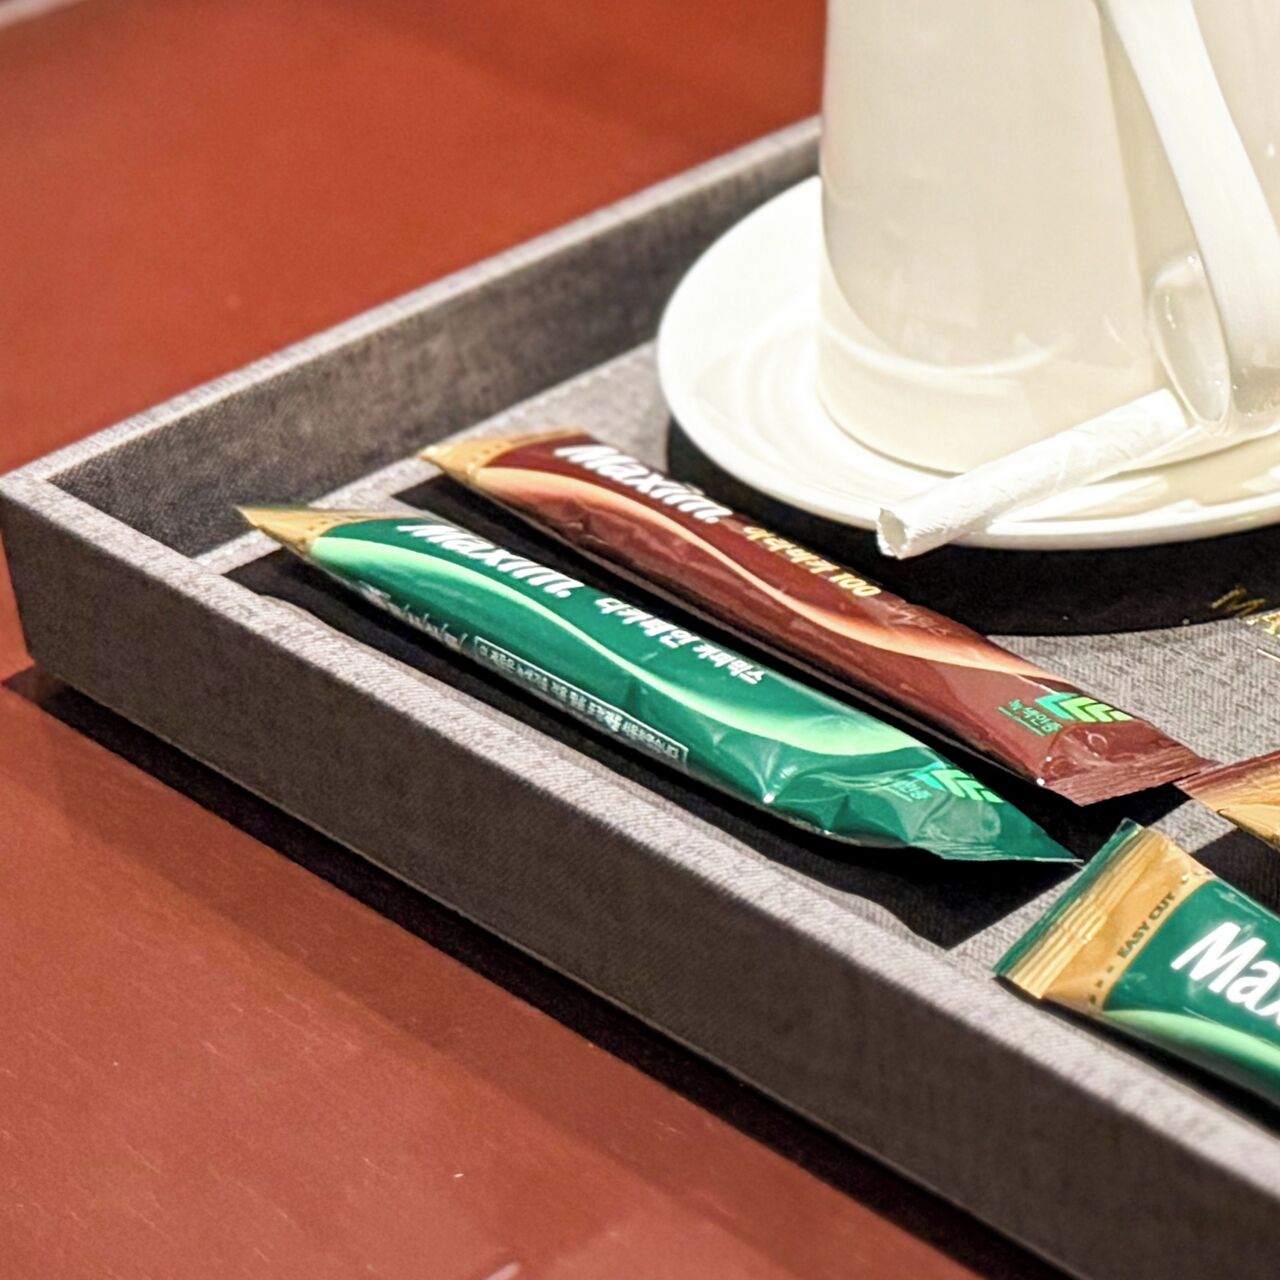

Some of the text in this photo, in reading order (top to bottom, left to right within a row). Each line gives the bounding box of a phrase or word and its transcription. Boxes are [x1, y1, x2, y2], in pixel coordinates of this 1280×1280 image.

[827, 571, 883, 597] 100
[594, 596, 701, 650] 디카페인
[1116, 920, 1151, 960] EASY
